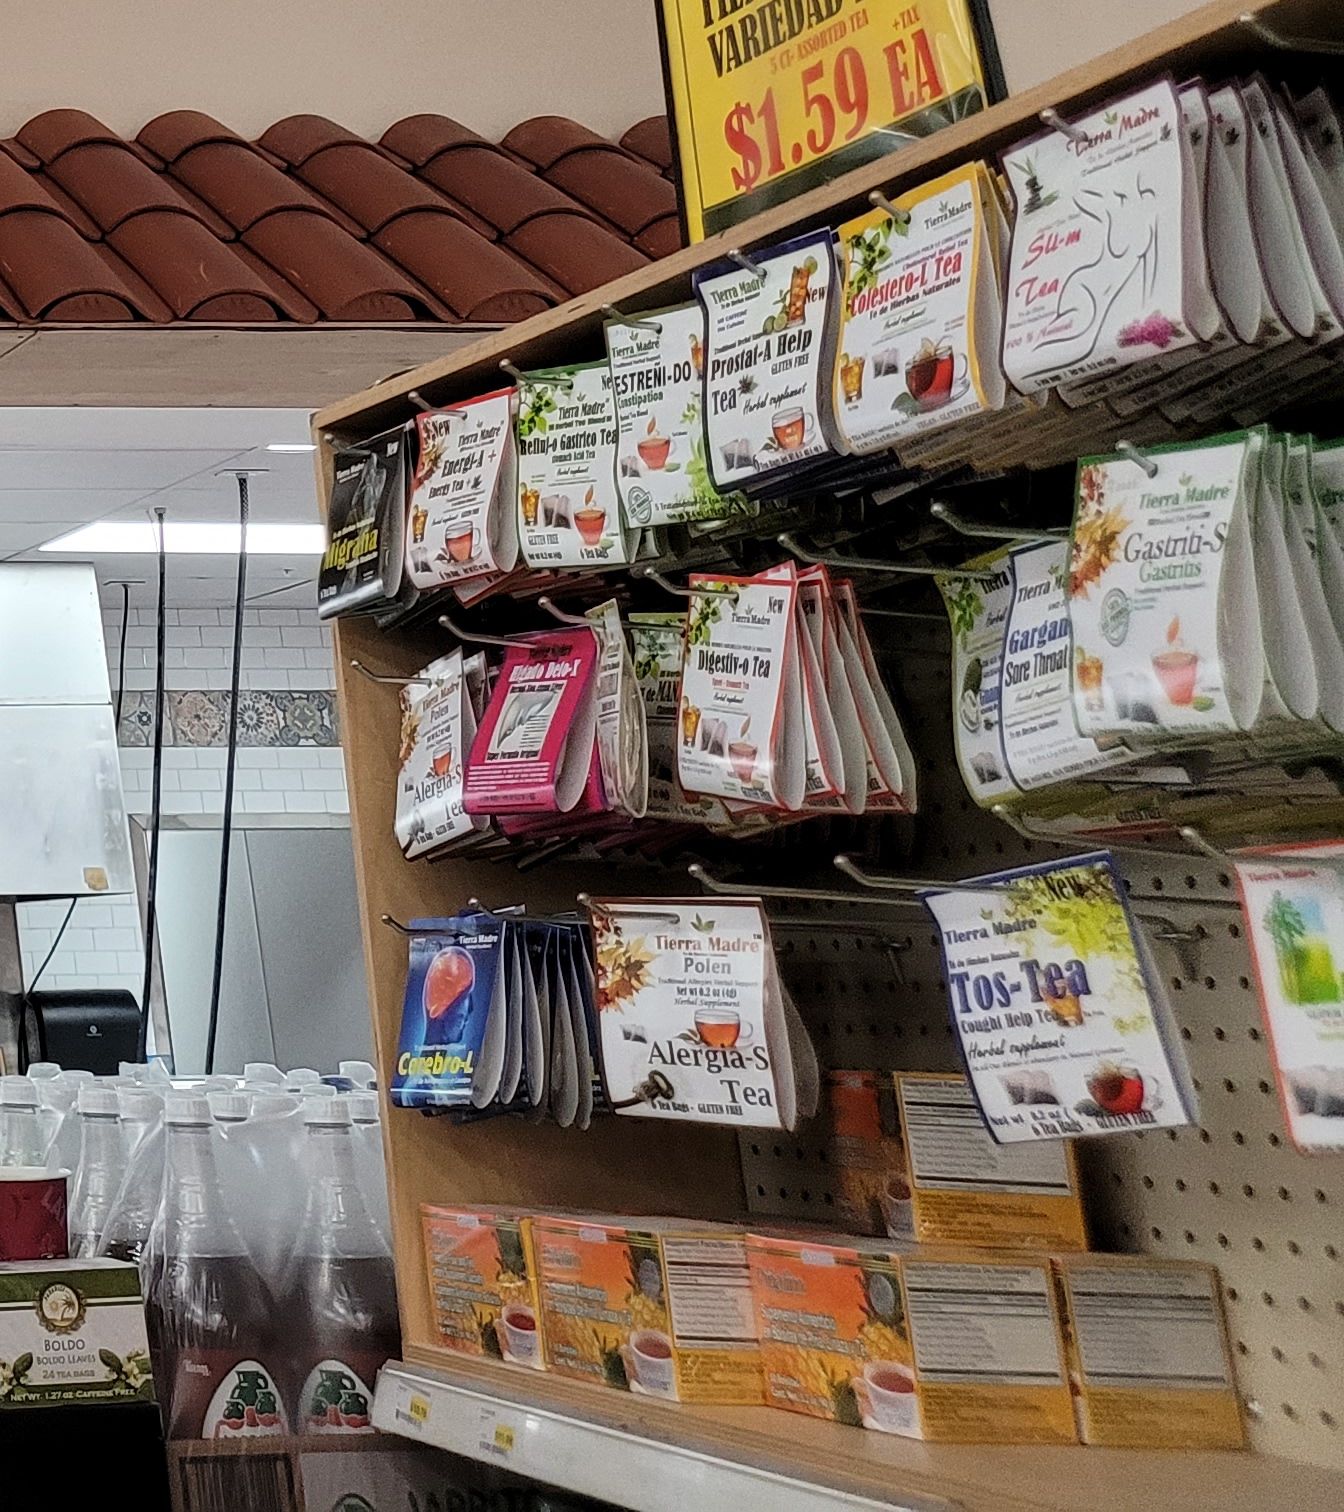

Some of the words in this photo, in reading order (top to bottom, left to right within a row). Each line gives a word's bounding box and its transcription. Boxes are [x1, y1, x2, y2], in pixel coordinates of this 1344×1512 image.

[795, 20, 847, 62] ASSORTED
[849, 8, 870, 33] TEA
[723, 46, 870, 195] $1.59
[882, 28, 945, 118] EA
[1119, 107, 1161, 140] Madre
[924, 212, 949, 230] Tierra
[948, 201, 972, 219] Madre
[934, 251, 962, 282] Tea
[710, 288, 739, 305] Tierra
[739, 278, 766, 296] Madre
[806, 286, 826, 304] New
[1015, 276, 1060, 307] Tea
[612, 345, 635, 359] Tierra
[636, 339, 661, 352] Madre
[710, 339, 772, 382] Prostat-A
[776, 329, 813, 358] Help
[613, 360, 692, 397] ESTREÑI-DO
[558, 405, 580, 421] Tierra
[581, 401, 606, 417] Madre
[712, 387, 737, 416] Tea
[431, 419, 451, 440] New
[560, 430, 597, 451] Gastrico
[599, 428, 617, 446] Tea
[428, 482, 451, 500] Energy
[451, 479, 465, 493] Tea
[1139, 492, 1180, 510] Tierra
[1185, 484, 1230, 502] Madre
[1124, 522, 1228, 564] Gastriti-S
[1139, 560, 1202, 584] Gastritis
[767, 595, 785, 614] New
[1017, 579, 1052, 604] Tierra
[732, 613, 751, 624] Tierra
[751, 614, 771, 626] Madre
[697, 649, 750, 676] Digestiv-o
[752, 655, 771, 679] Tea
[1005, 660, 1031, 688] Sore
[1032, 644, 1068, 680] Throat
[430, 704, 449, 724] Polen
[413, 763, 463, 807] Alergia-S
[655, 934, 702, 951] Tierra
[708, 936, 760, 953] Madre
[944, 928, 990, 946] Tierra
[992, 918, 1037, 936] Madre
[683, 956, 732, 975] Polen
[949, 958, 1092, 1014] Tos-Tea
[1005, 1010, 1033, 1028] Help
[1036, 1008, 1060, 1024] Tea
[647, 1040, 770, 1075] Alergia-S
[720, 1079, 774, 1108] Tea
[44, 1338, 86, 1352] BOLDO
[37, 1355, 65, 1366] BOLDO
[67, 1354, 96, 1365] LEAVES
[42, 1370, 55, 1380] 24
[56, 1370, 72, 1379] TEA
[45, 1391, 63, 1401] 1.27
[115, 1388, 136, 1398] FREE
